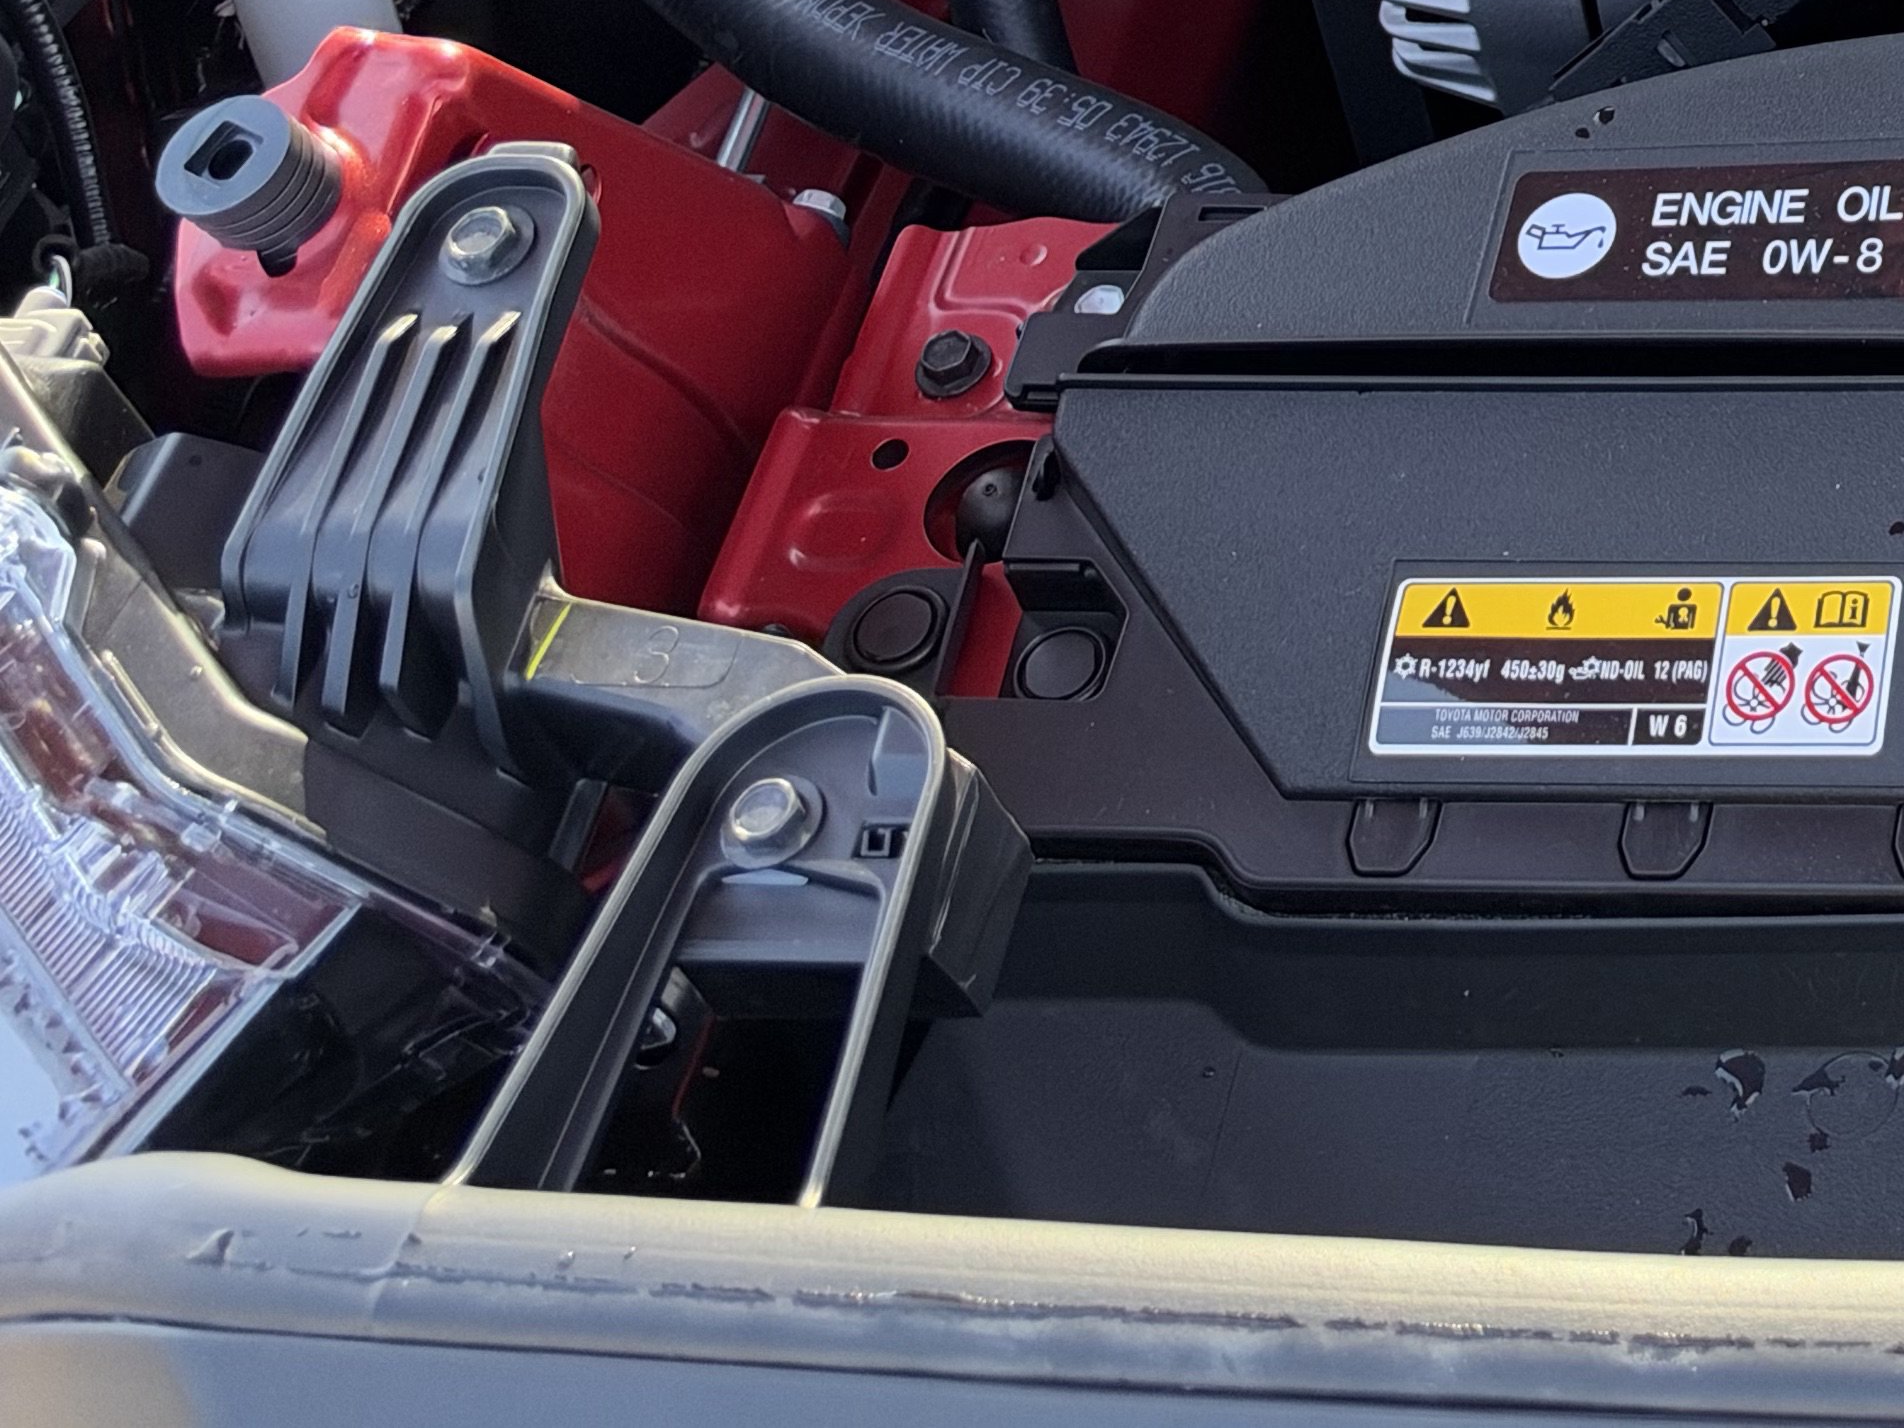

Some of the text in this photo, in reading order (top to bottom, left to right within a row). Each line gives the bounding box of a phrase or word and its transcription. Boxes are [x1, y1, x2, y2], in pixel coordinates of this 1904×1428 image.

[874, 21, 965, 77] WATER
[957, 49, 1023, 96] CIP
[1651, 186, 1904, 227] ENGINE OIL
[1641, 237, 1885, 279] SAE 0W-8
[1418, 657, 1708, 684] R-1234yf 450±30g ND-OIL 12 (PAG)
[1430, 725, 1549, 741] SAE J639/J2842/J2845
[1434, 708, 1580, 724] TOYOTA MOTOR CORPORATION
[1648, 715, 1688, 738] W 6
